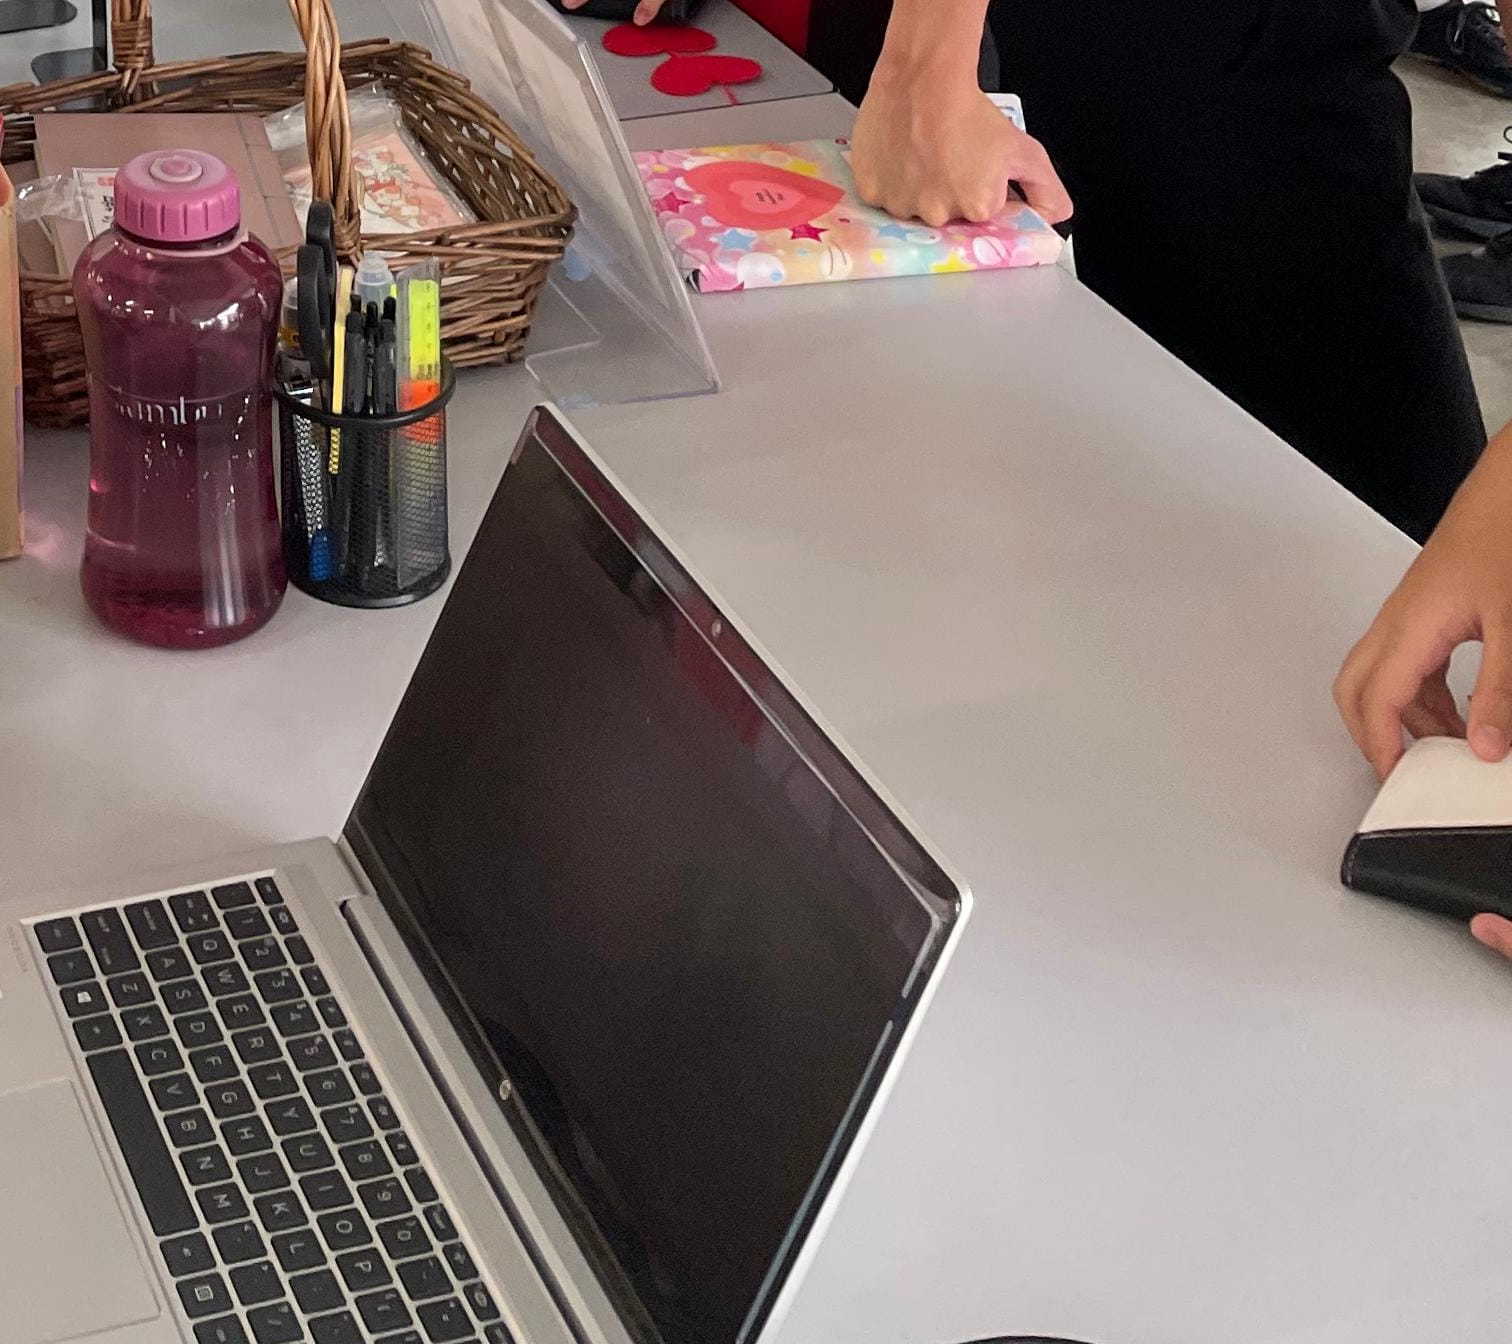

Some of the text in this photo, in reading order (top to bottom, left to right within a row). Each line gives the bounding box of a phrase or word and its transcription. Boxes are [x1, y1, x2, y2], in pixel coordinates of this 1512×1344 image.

[218, 969, 235, 984] W
[122, 983, 138, 993] Z
[176, 990, 191, 1000] S
[233, 1004, 249, 1015] E
[137, 1016, 152, 1026] X
[190, 1021, 205, 1033] D
[247, 1036, 264, 1048] R
[152, 1051, 167, 1060] C
[205, 1056, 222, 1067] F
[266, 1072, 281, 1082] T
[167, 1083, 183, 1095] V
[222, 1092, 237, 1103] G
[283, 1107, 299, 1119] Y
[341, 1116, 355, 1125] 7
[237, 1127, 255, 1140] H
[300, 1144, 317, 1157] U
[197, 1156, 214, 1170] N
[254, 1167, 271, 1176] J
[213, 1193, 232, 1209] M
[272, 1202, 288, 1215] K
[336, 1219, 353, 1234] O
[290, 1242, 304, 1255] L
[355, 1261, 371, 1272] P
